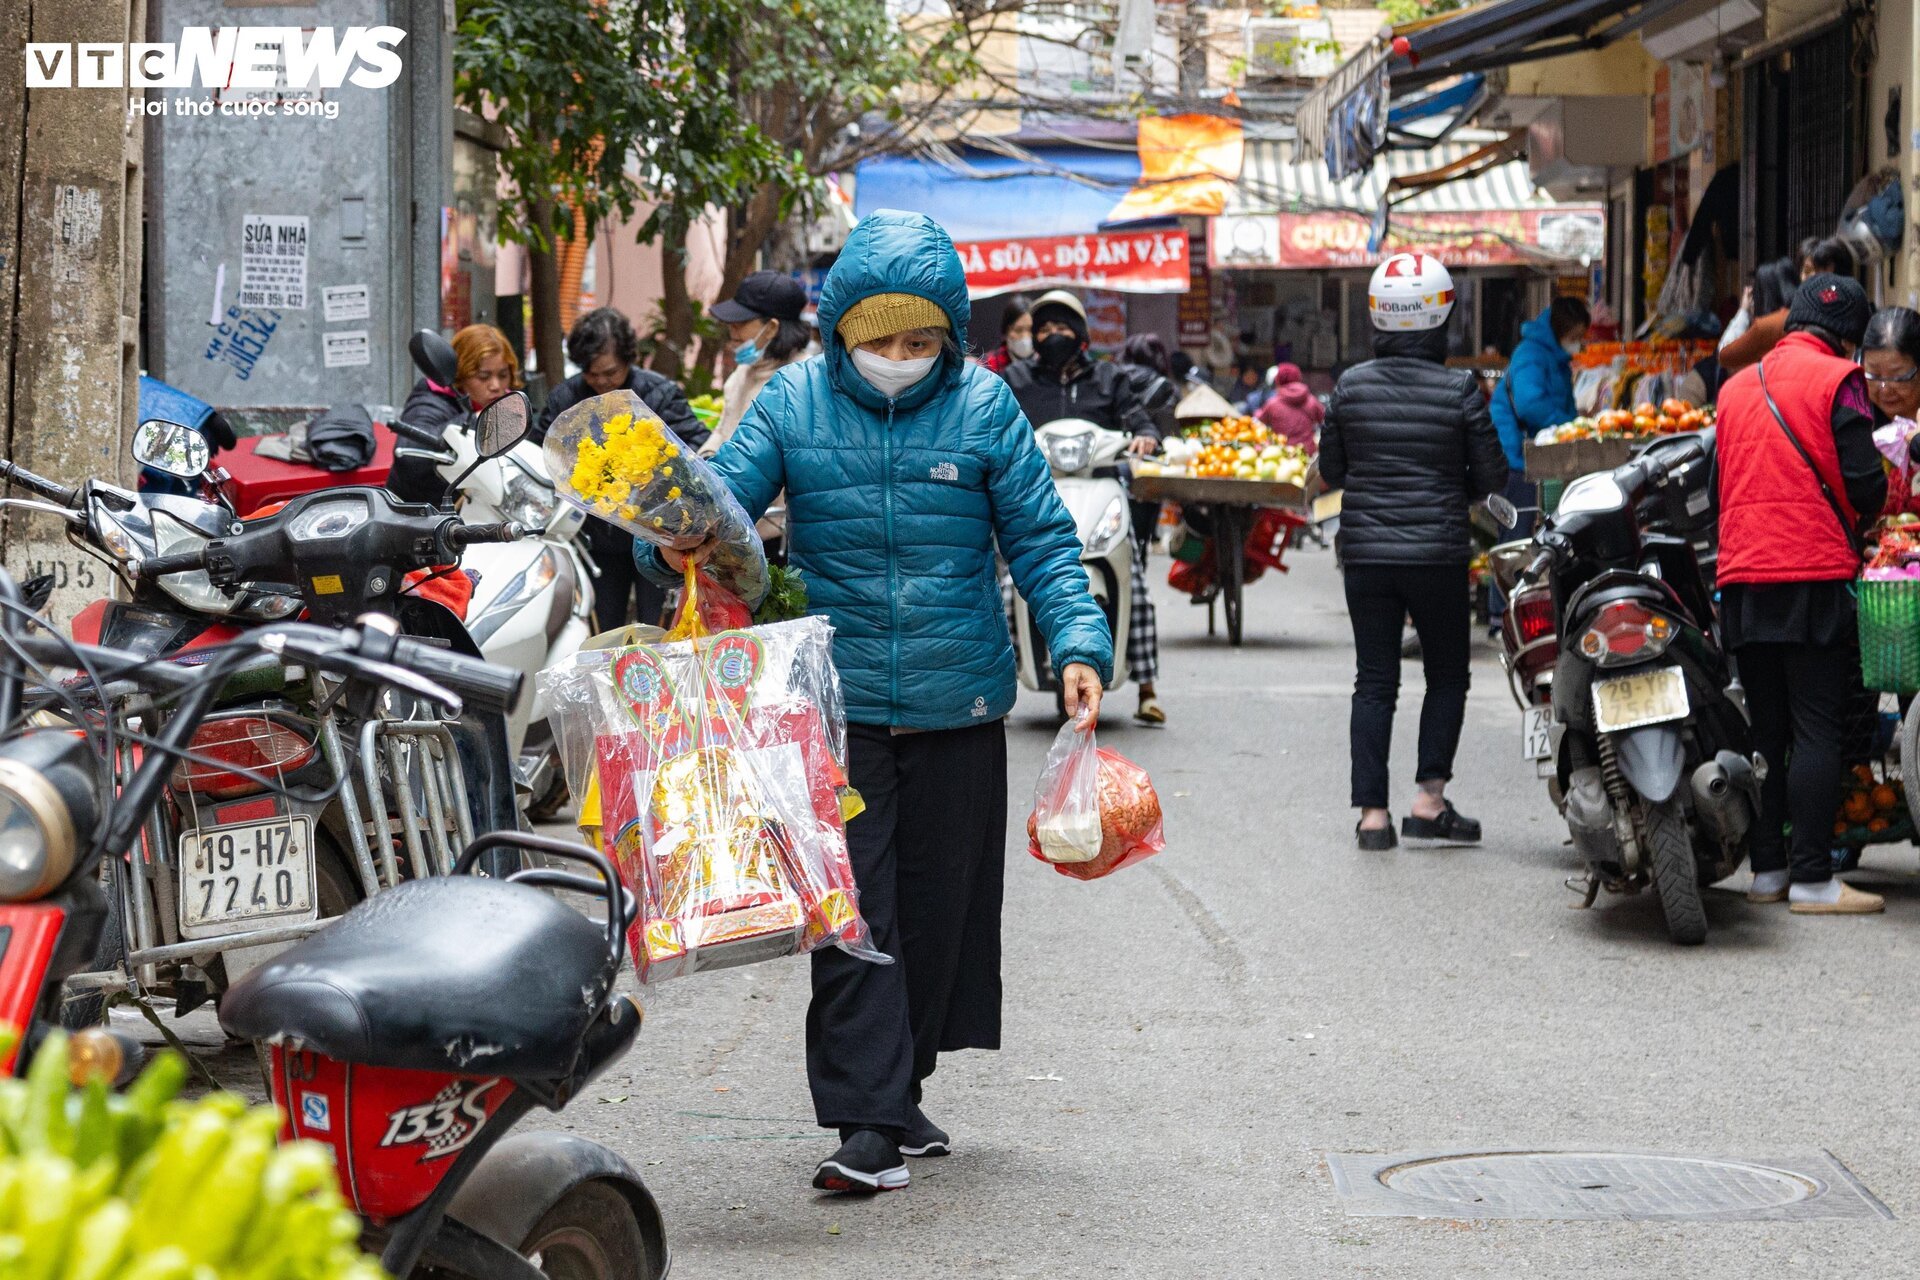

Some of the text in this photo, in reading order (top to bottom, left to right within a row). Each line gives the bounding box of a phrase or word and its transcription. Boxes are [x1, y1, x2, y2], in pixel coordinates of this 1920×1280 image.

[245, 217, 307, 243] SỬA NHÀ
[989, 242, 1039, 272] SỮA
[1055, 236, 1090, 267] ĐỒ
[1094, 237, 1130, 265] ĂN
[1133, 233, 1184, 267] VẶT
[1378, 301, 1423, 313] HDBank
[202, 826, 292, 874] 19-H7
[200, 869, 293, 920] 7240
